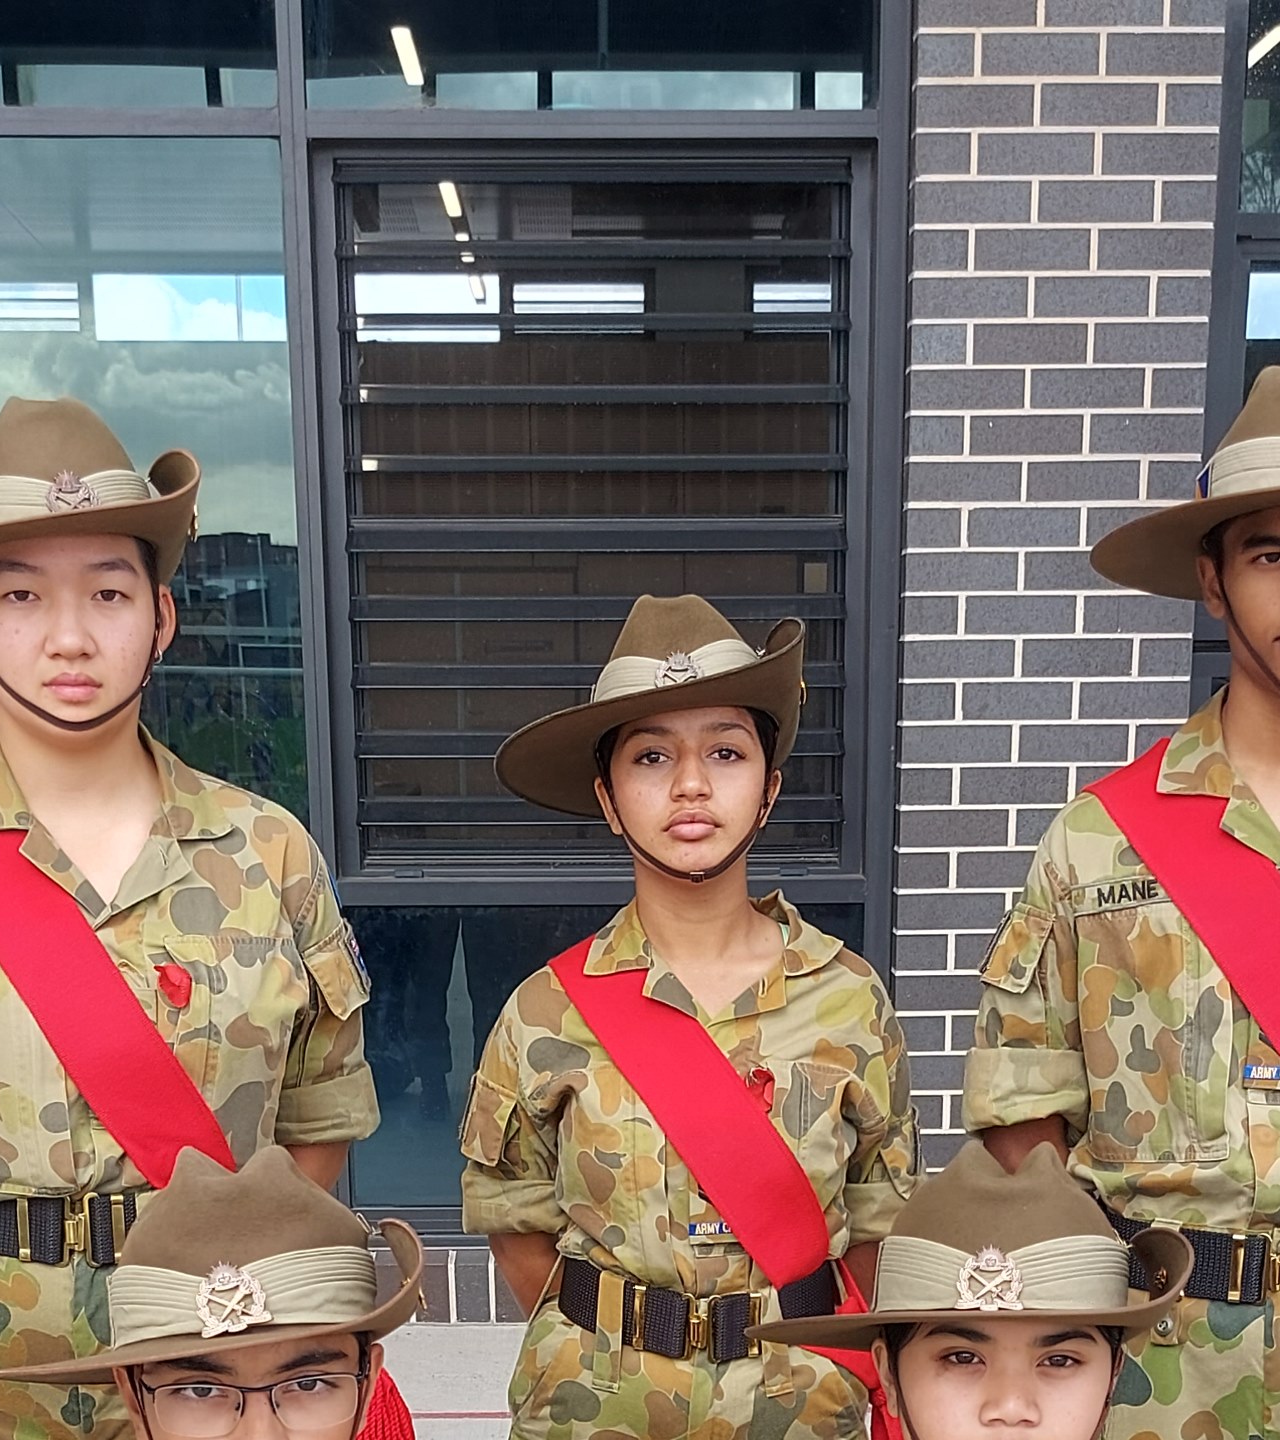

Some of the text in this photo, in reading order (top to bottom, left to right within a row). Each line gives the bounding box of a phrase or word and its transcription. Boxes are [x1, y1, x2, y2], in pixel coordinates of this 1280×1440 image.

[1097, 880, 1159, 908] MANE
[1250, 1066, 1278, 1079] ARMY
[695, 1222, 721, 1235] ARMY
